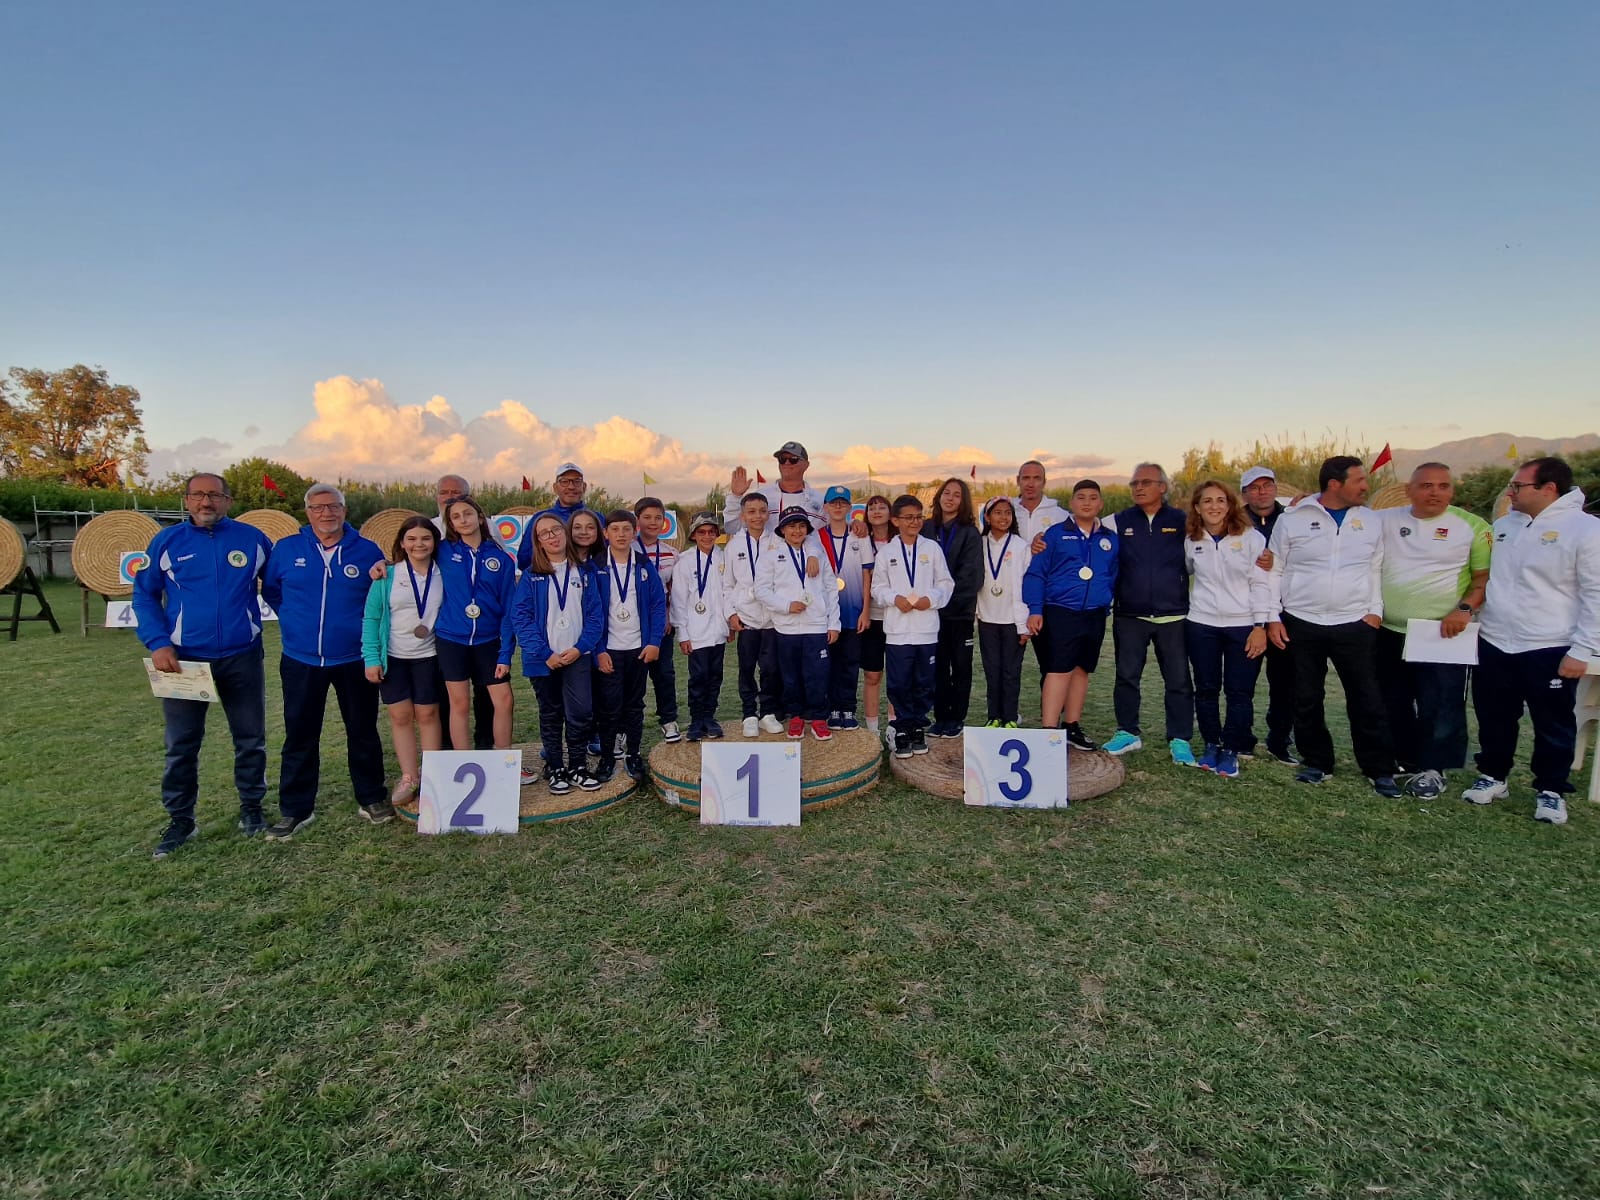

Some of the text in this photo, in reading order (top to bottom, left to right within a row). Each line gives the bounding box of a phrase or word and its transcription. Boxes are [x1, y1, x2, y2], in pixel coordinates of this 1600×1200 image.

[118, 605, 132, 624] 4
[450, 763, 486, 826] 2
[737, 754, 759, 818] 1
[999, 739, 1032, 801] 3
